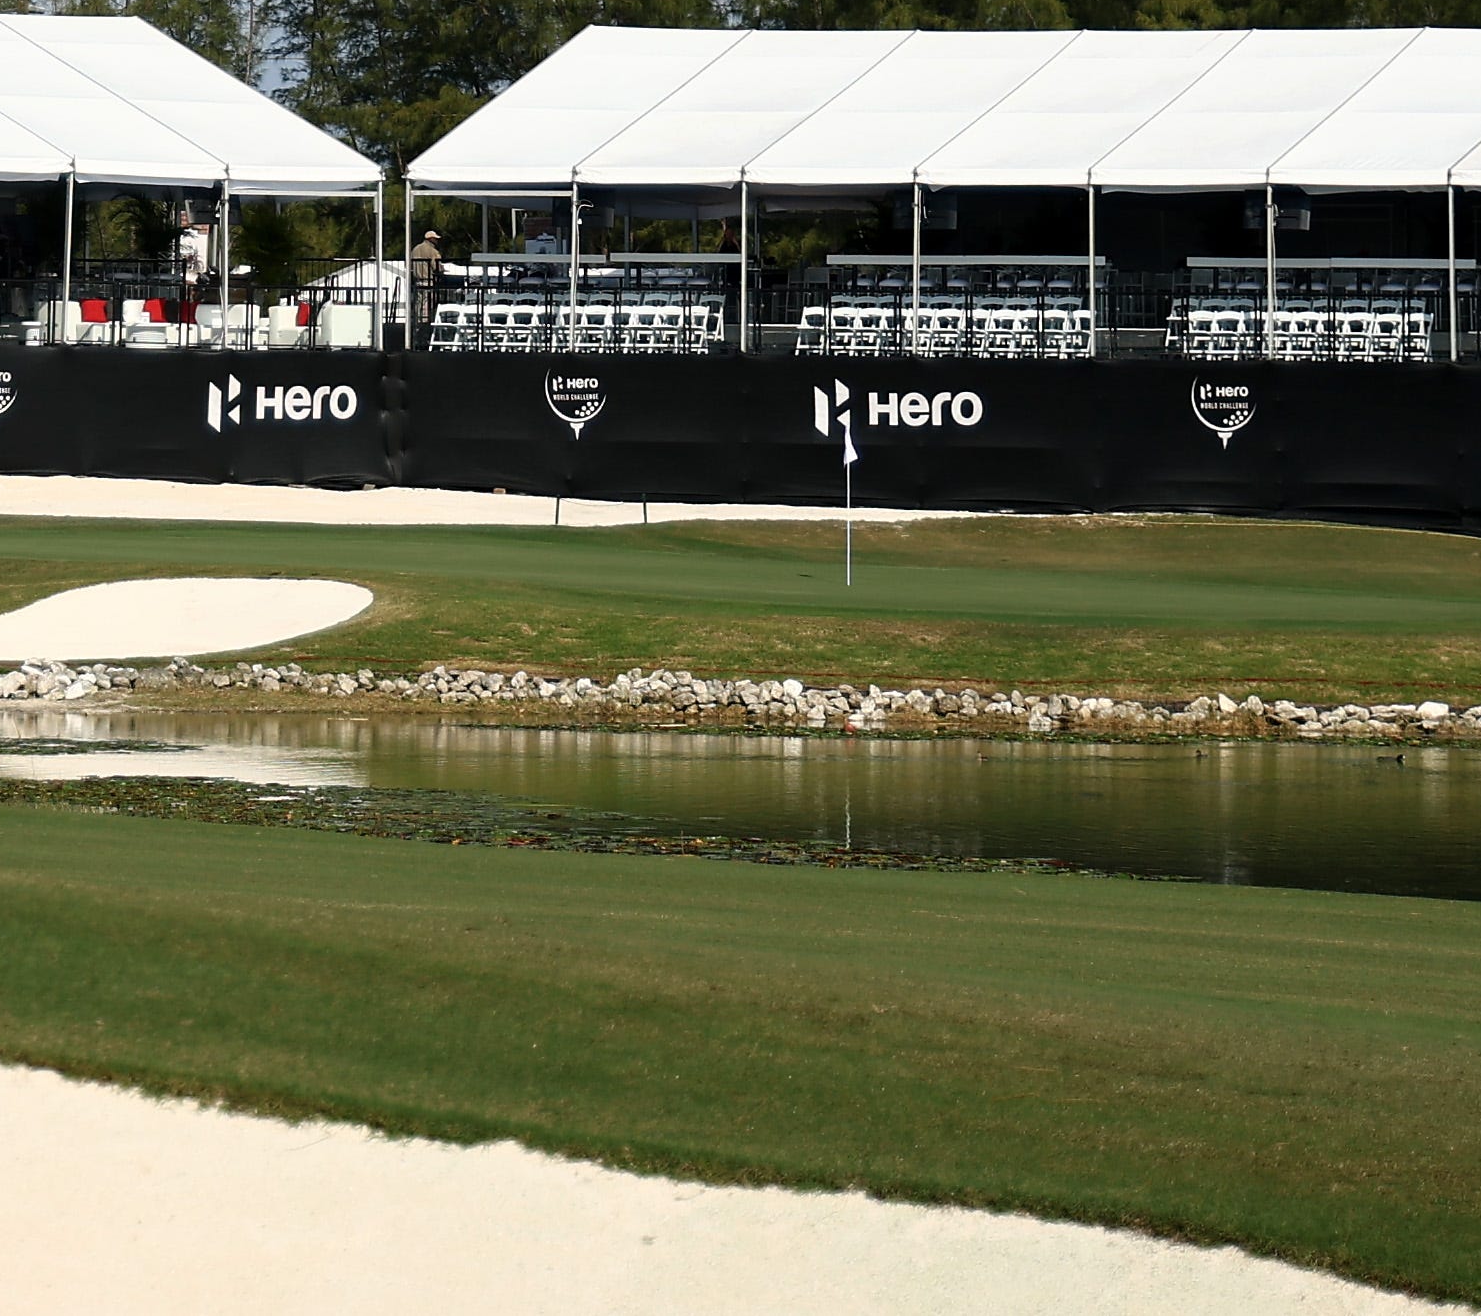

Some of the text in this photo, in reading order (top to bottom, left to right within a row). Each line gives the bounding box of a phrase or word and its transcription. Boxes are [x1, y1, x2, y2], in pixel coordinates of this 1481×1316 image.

[566, 378, 599, 389] Hero
[1215, 386, 1249, 397] Hero
[255, 385, 358, 421] Hero
[868, 391, 983, 427] Hero
